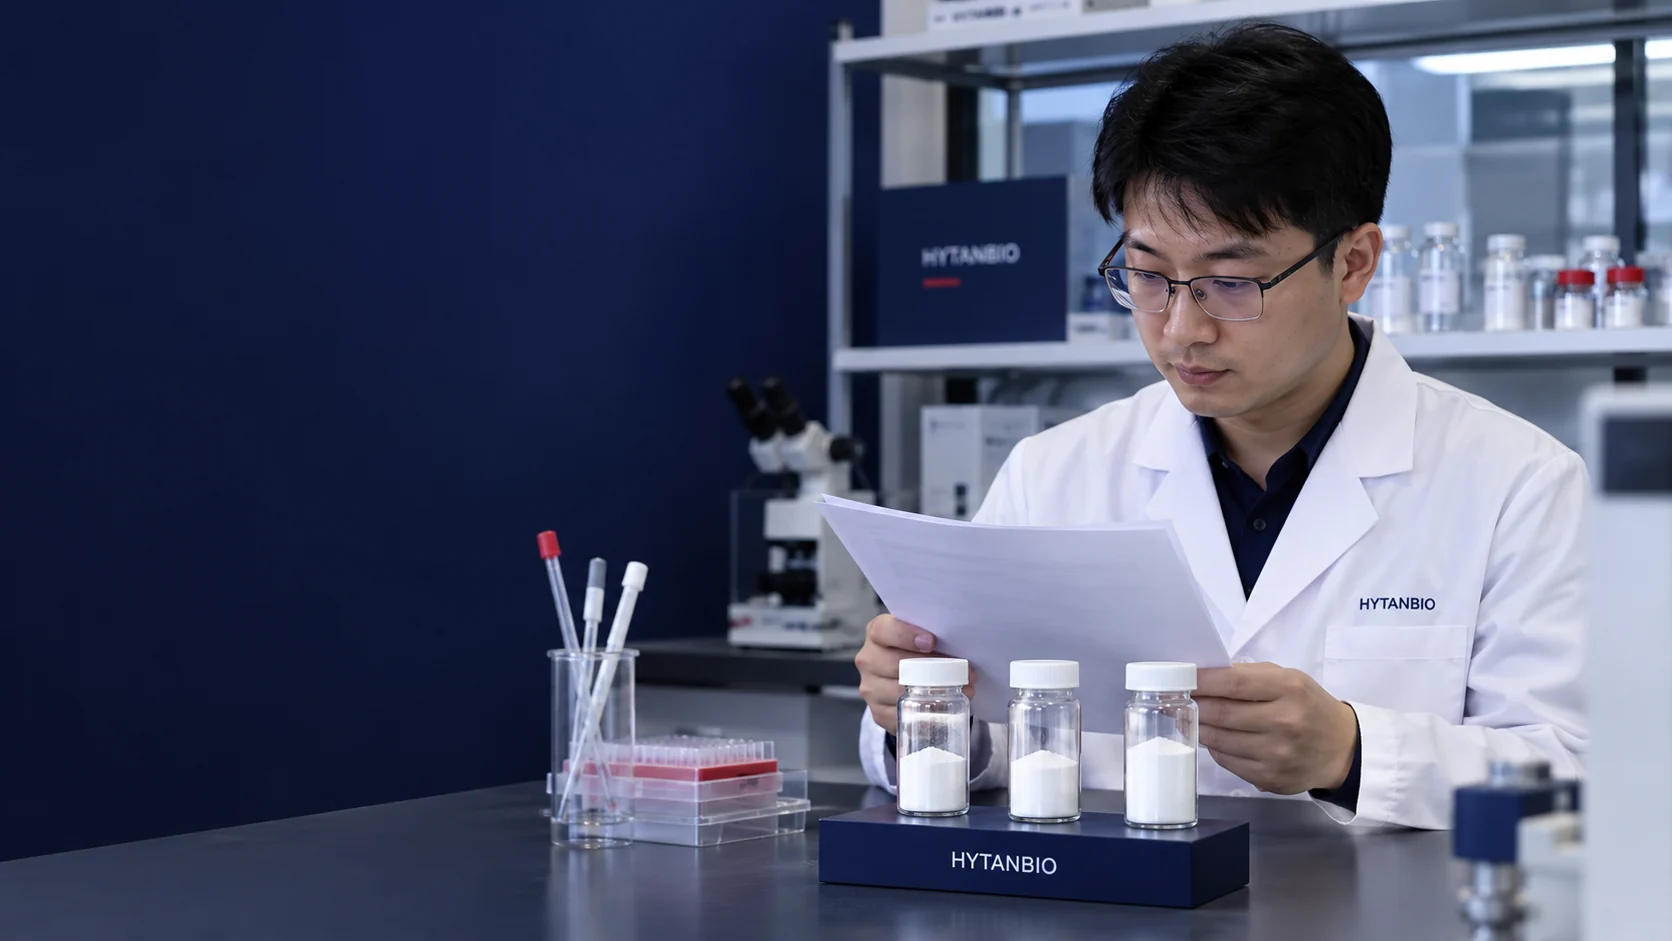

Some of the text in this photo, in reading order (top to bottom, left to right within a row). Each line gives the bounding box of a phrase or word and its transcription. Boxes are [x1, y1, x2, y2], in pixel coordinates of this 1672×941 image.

[921, 242, 1021, 267] HYTANBIO
[1359, 597, 1436, 611] HYTANBIO
[951, 851, 1057, 875] HYTANBIO
